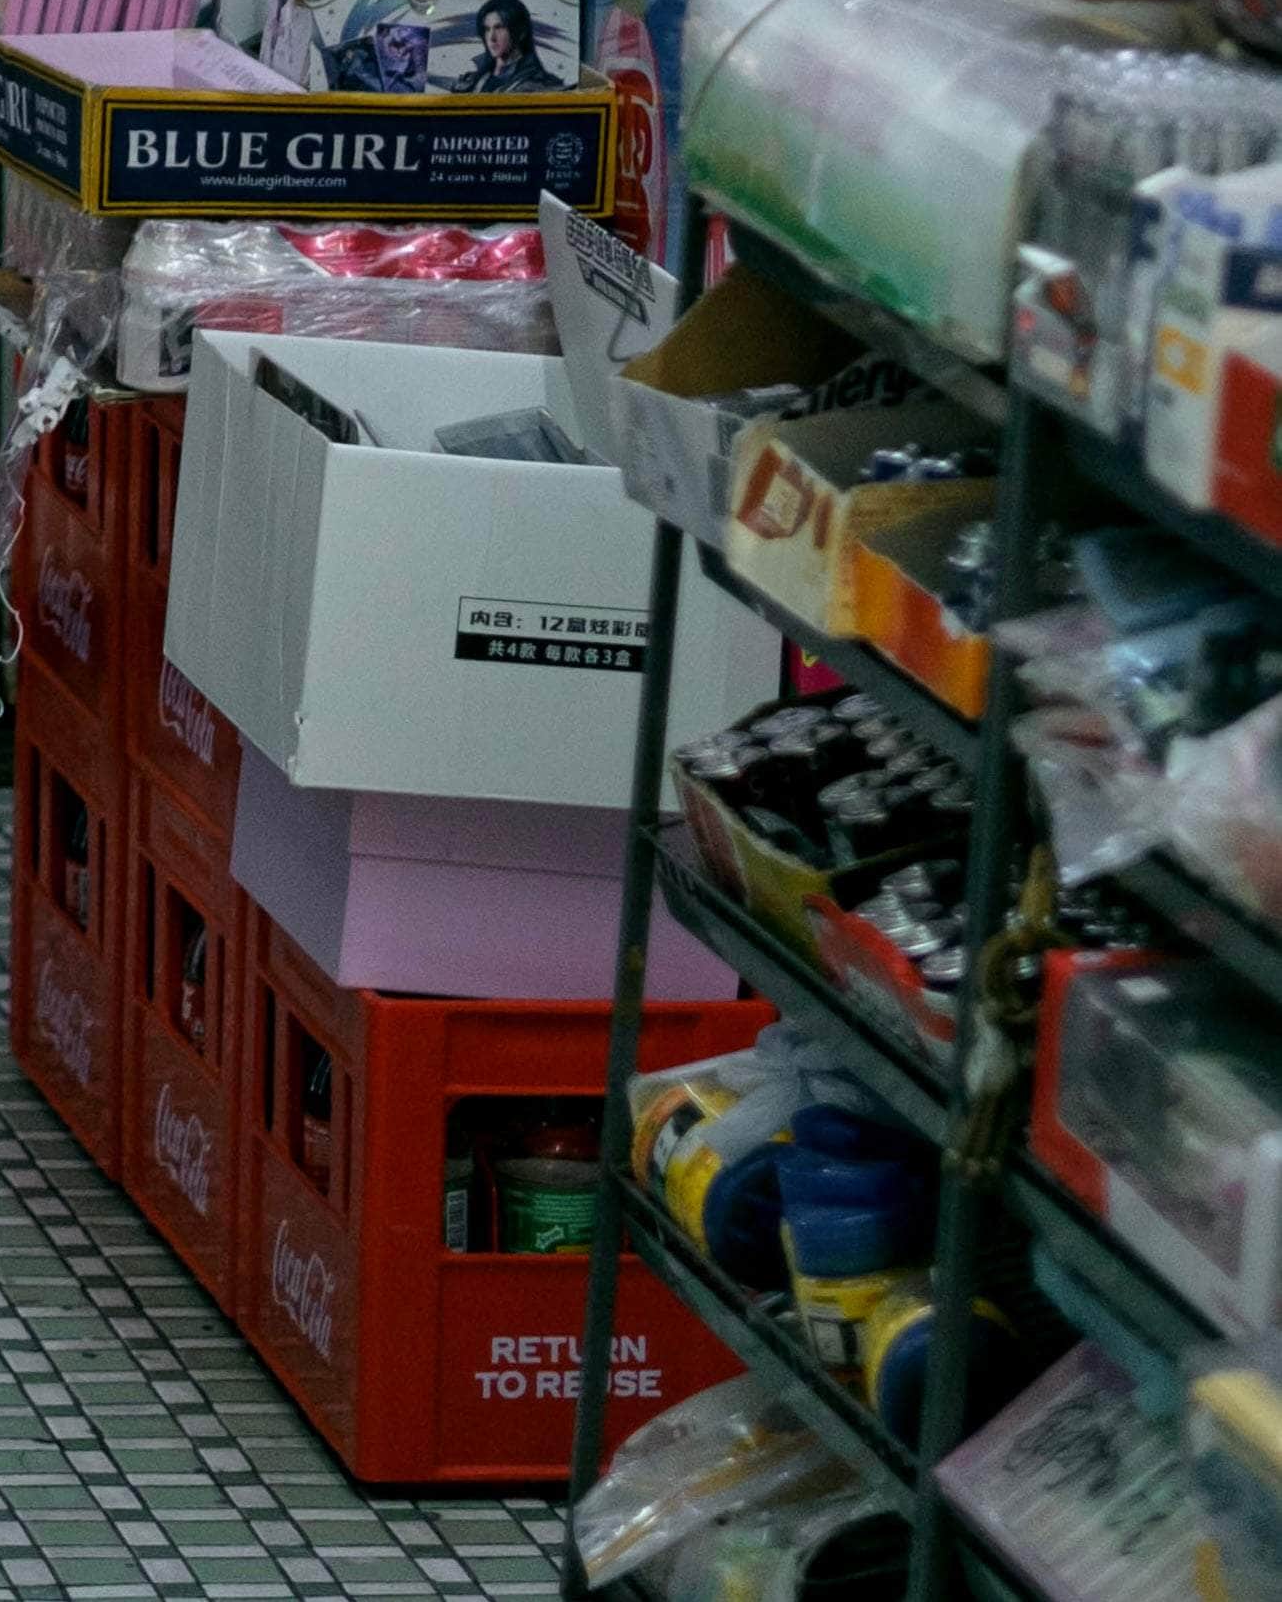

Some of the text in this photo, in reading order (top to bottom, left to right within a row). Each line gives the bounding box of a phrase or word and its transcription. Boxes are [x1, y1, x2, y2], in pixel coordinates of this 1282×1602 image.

[126, 129, 420, 171] BLUE GIRL
[432, 135, 530, 151] IMPORTED
[430, 153, 530, 165] PREMIUM BEER
[199, 173, 347, 191] www.bluegirlbeer.com
[487, 640, 537, 660] 共4款
[474, 1368, 663, 1400] TO RESE
